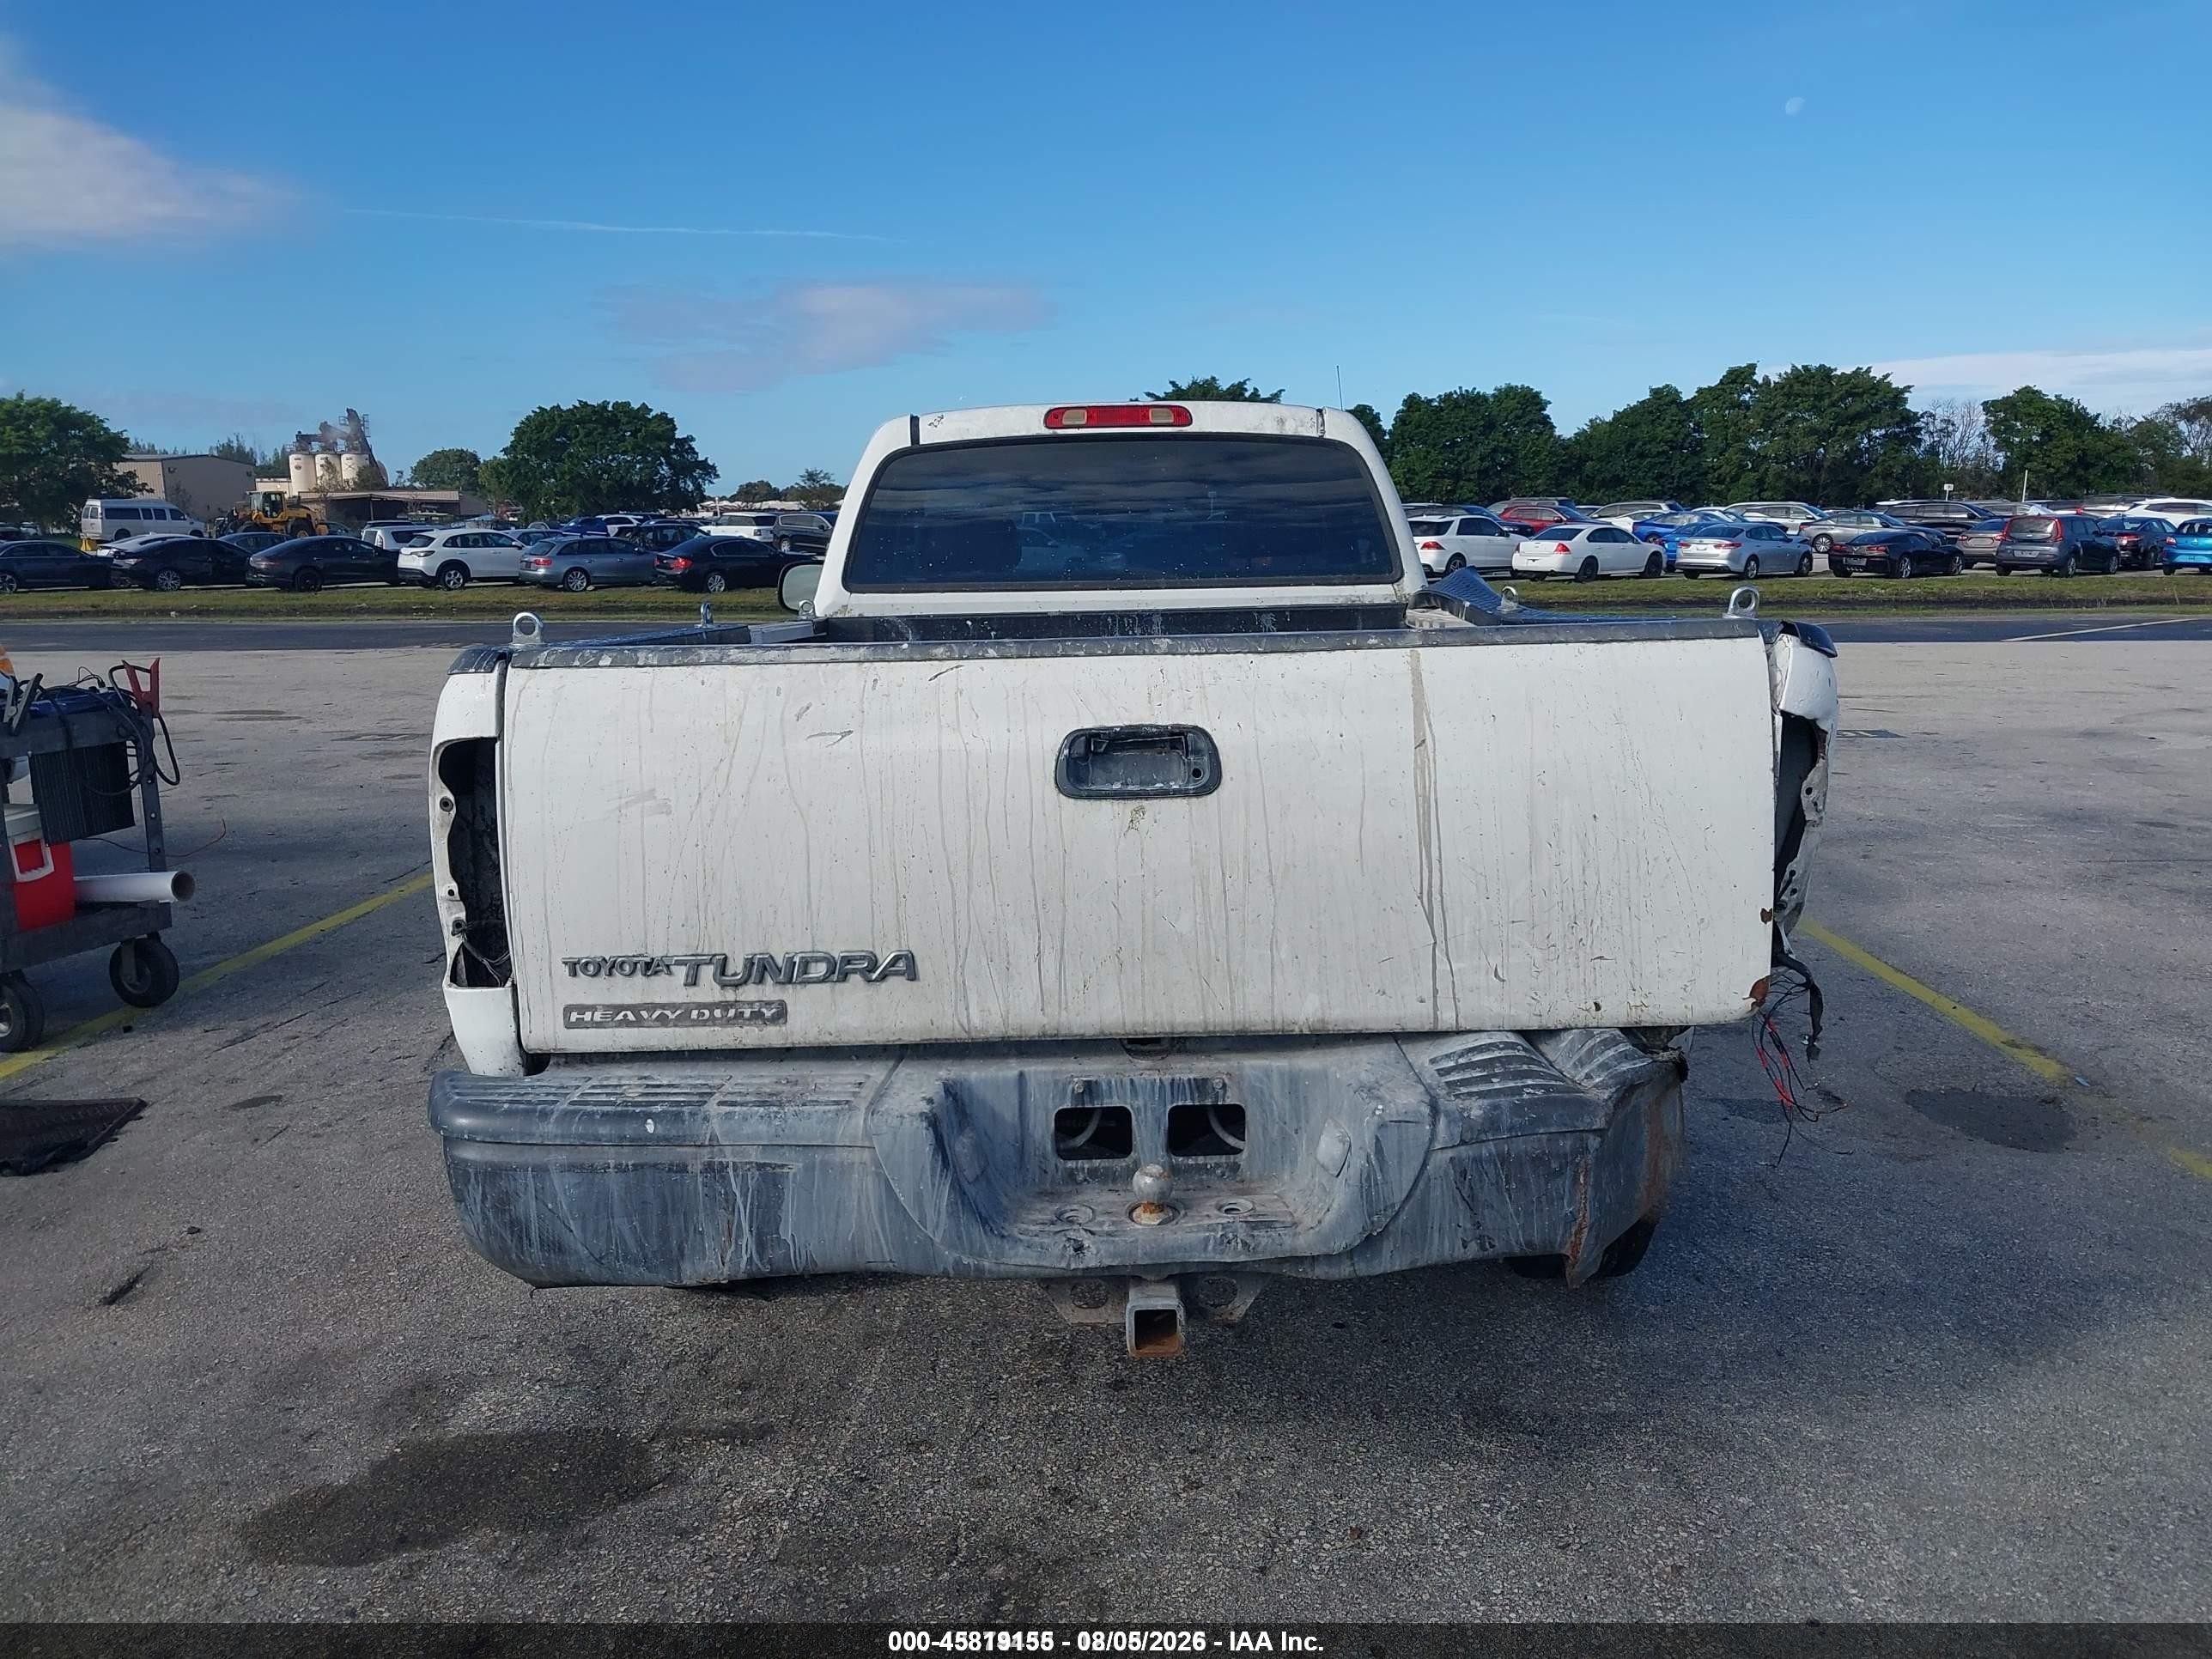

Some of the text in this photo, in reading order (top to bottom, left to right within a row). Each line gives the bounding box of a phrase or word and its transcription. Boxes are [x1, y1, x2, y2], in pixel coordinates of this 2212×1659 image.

[562, 949, 916, 987] TOYOTA TUNDRA
[568, 1007, 779, 1023] HEAVY DUTY
